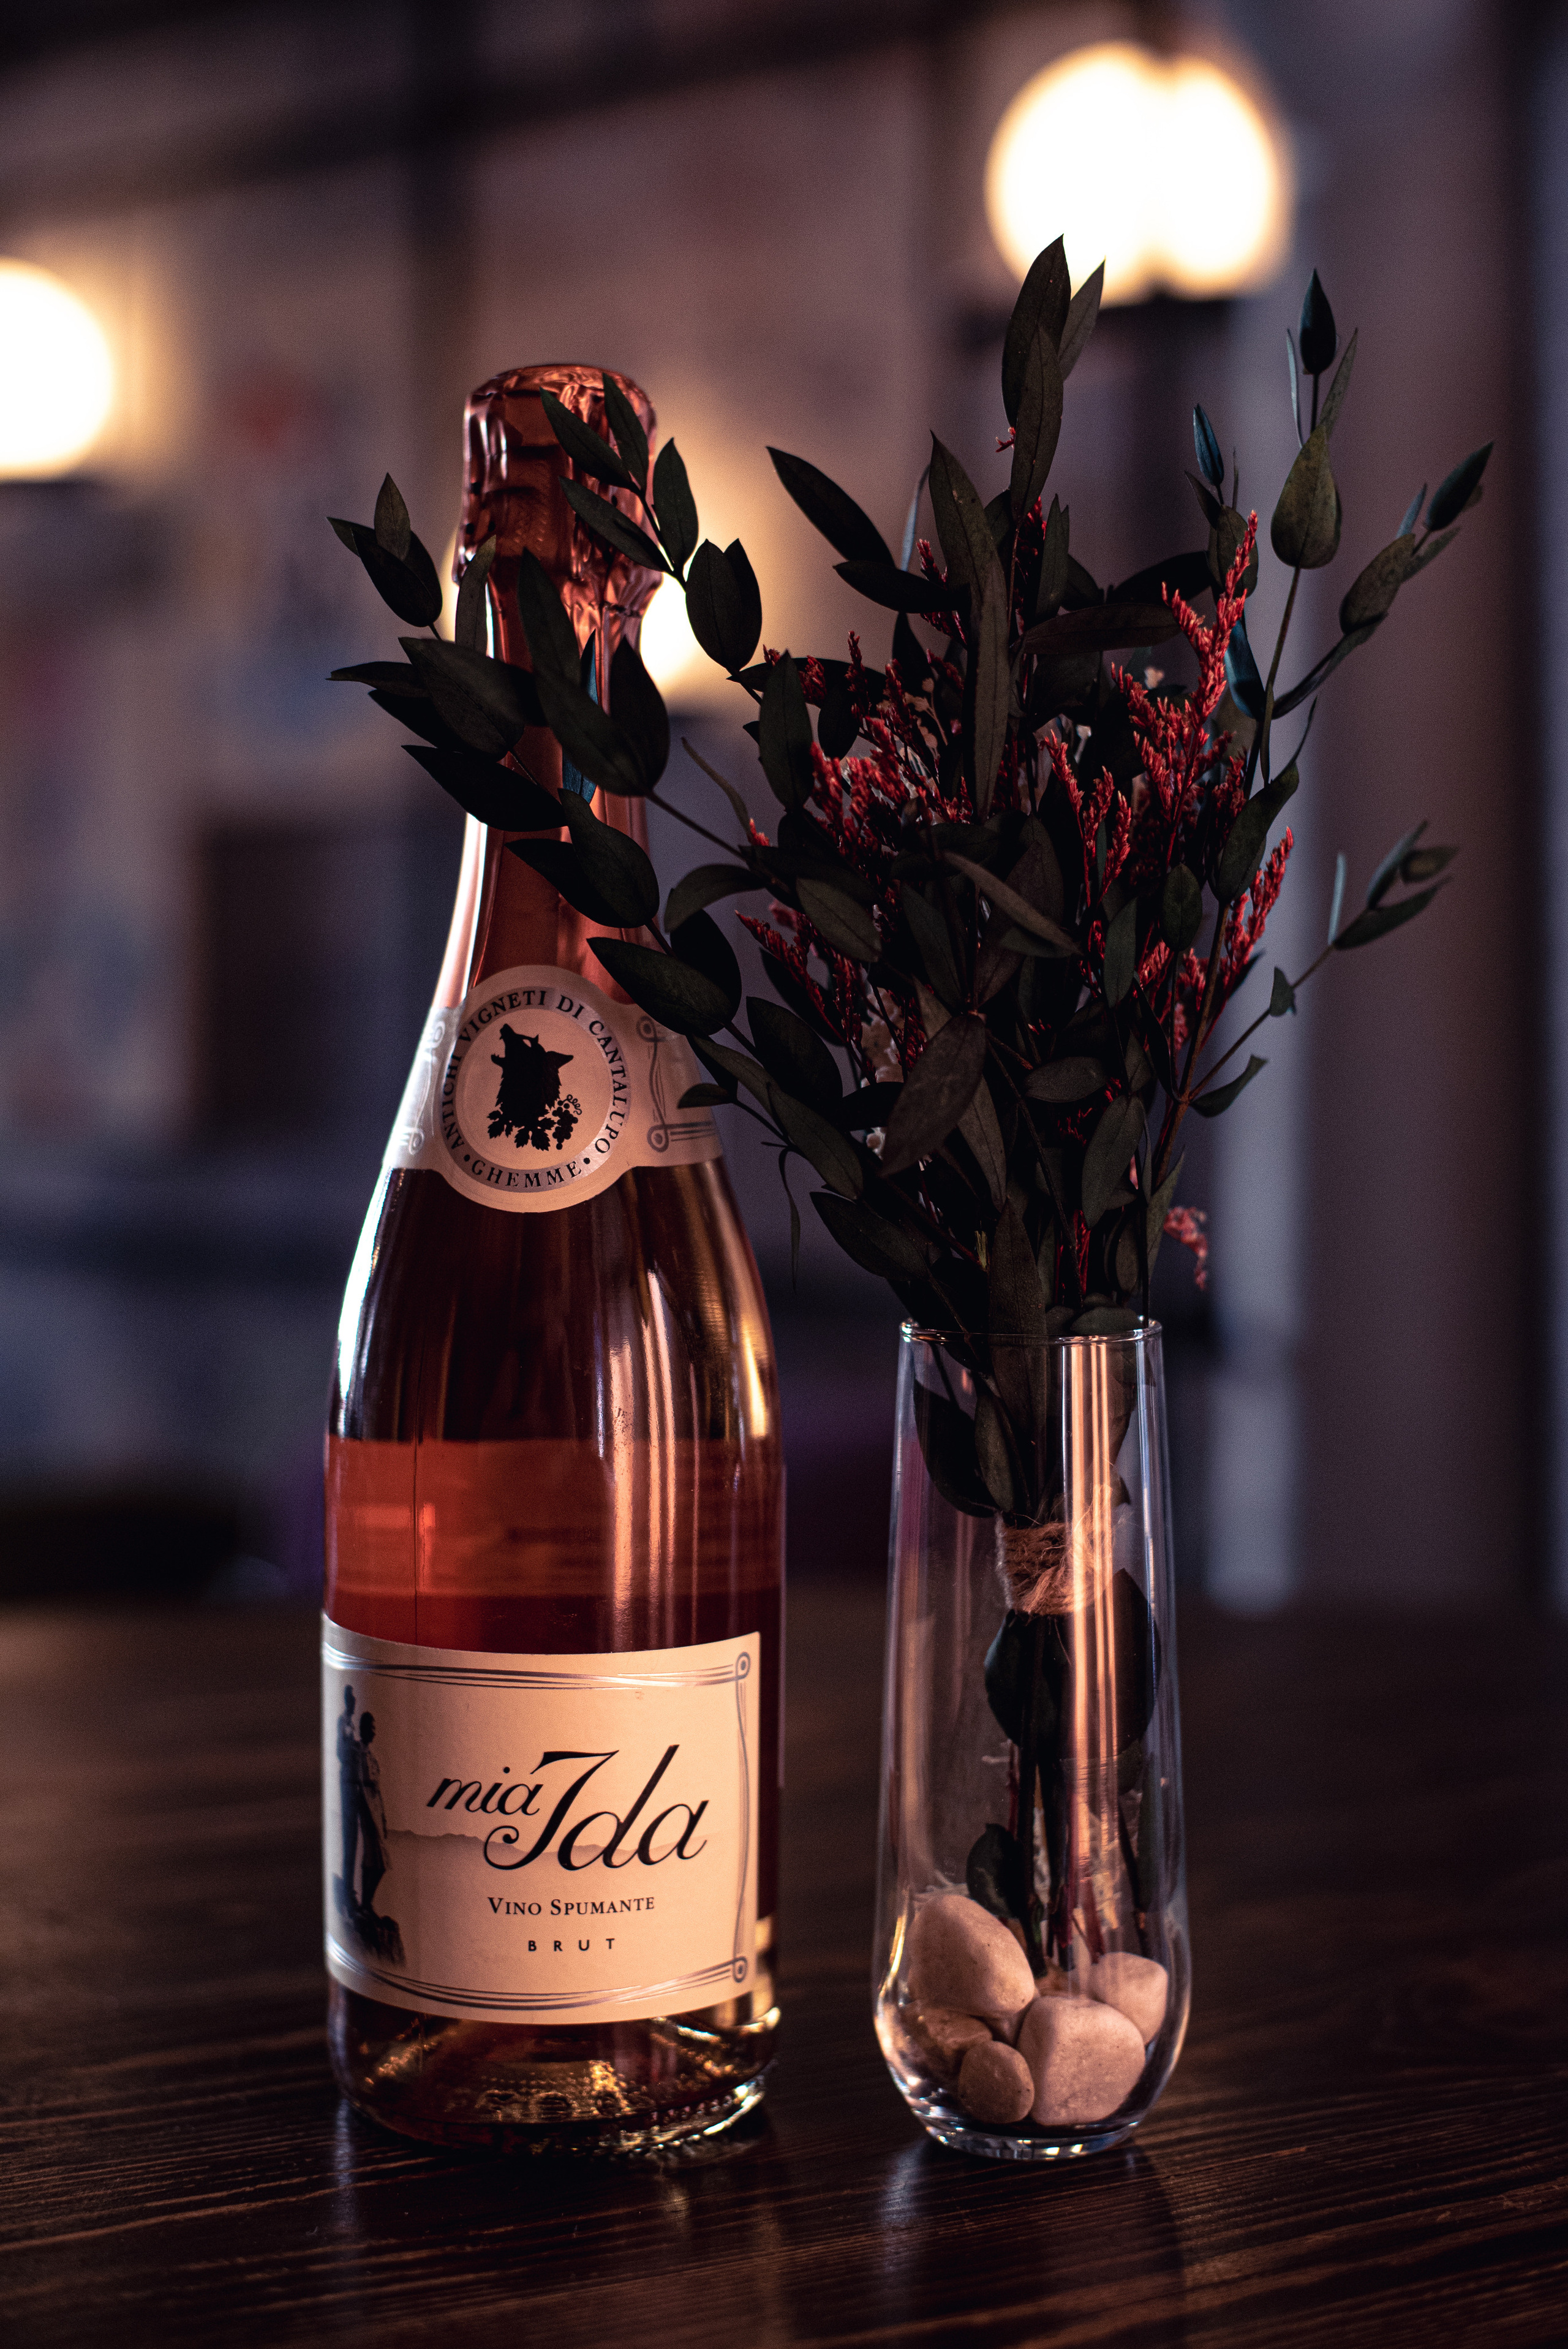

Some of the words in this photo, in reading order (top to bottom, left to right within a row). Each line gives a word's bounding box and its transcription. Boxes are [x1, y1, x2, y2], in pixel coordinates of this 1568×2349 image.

[441, 1054, 463, 1151] ANTICHI
[460, 990, 547, 1043] VIGNETI
[556, 995, 584, 1019] DI
[589, 1020, 628, 1154] CANTALUPO
[472, 1160, 581, 1189] GHEMME
[426, 1766, 543, 1816] mia
[484, 1744, 709, 1871] Ida
[528, 1939, 616, 1952] BRUT
